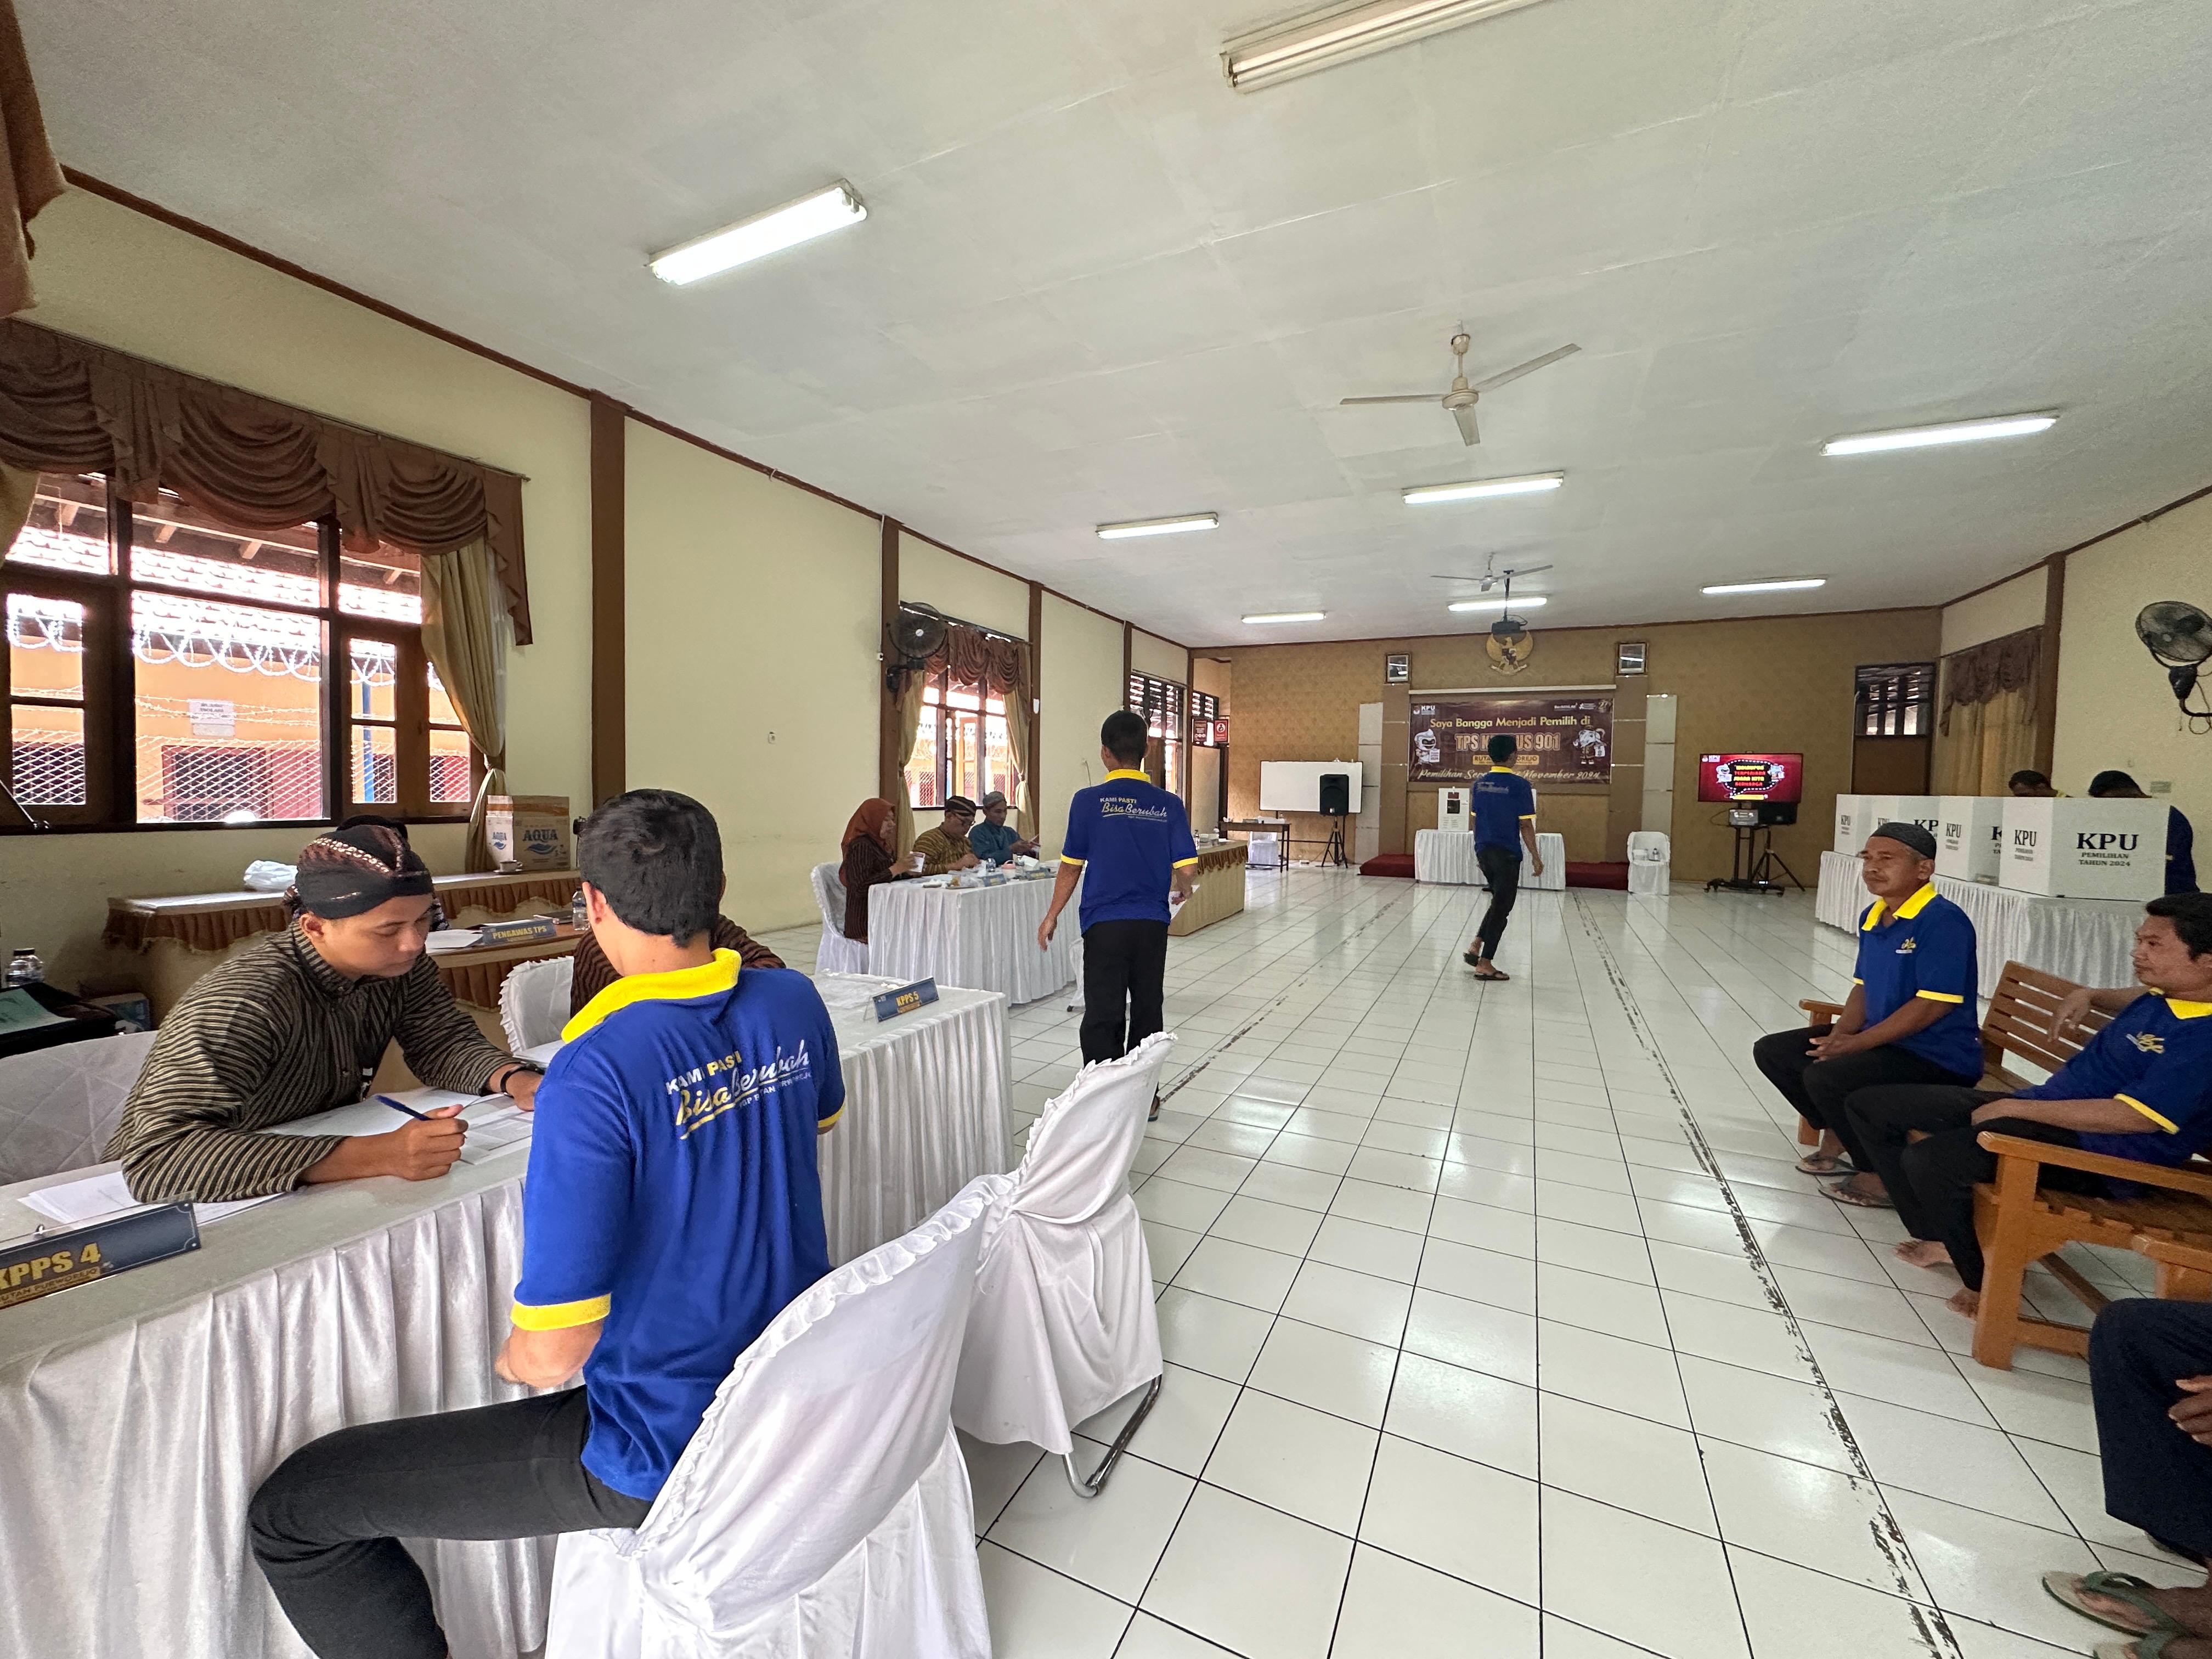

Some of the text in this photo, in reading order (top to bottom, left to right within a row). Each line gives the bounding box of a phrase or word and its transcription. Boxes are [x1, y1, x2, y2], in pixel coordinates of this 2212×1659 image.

[1430, 715, 1590, 729] Saya Bangga Menjadi Pemilih di
[1455, 733, 1479, 751] TPS
[1536, 733, 1560, 751] 901
[1418, 769, 1463, 779] Pemilihan
[1523, 769, 1575, 779] November
[1577, 771, 1601, 780] 2024
[1101, 802, 1167, 817] Bisa Berubah
[1841, 815, 1851, 826] KPU
[1914, 819, 1938, 831] KP
[492, 832, 507, 842] AQUA
[523, 829, 558, 843] AQUA
[1946, 823, 1961, 838] KPU
[2015, 830, 2036, 846] KPU
[2076, 833, 2139, 850] KPU
[493, 927, 533, 940] PENGAWAS
[533, 925, 547, 934] TPS
[895, 992, 914, 1007] KPPS
[913, 991, 919, 1001] 5
[81, 1243, 101, 1263] 4
[0, 1287, 31, 1302] UTAN
